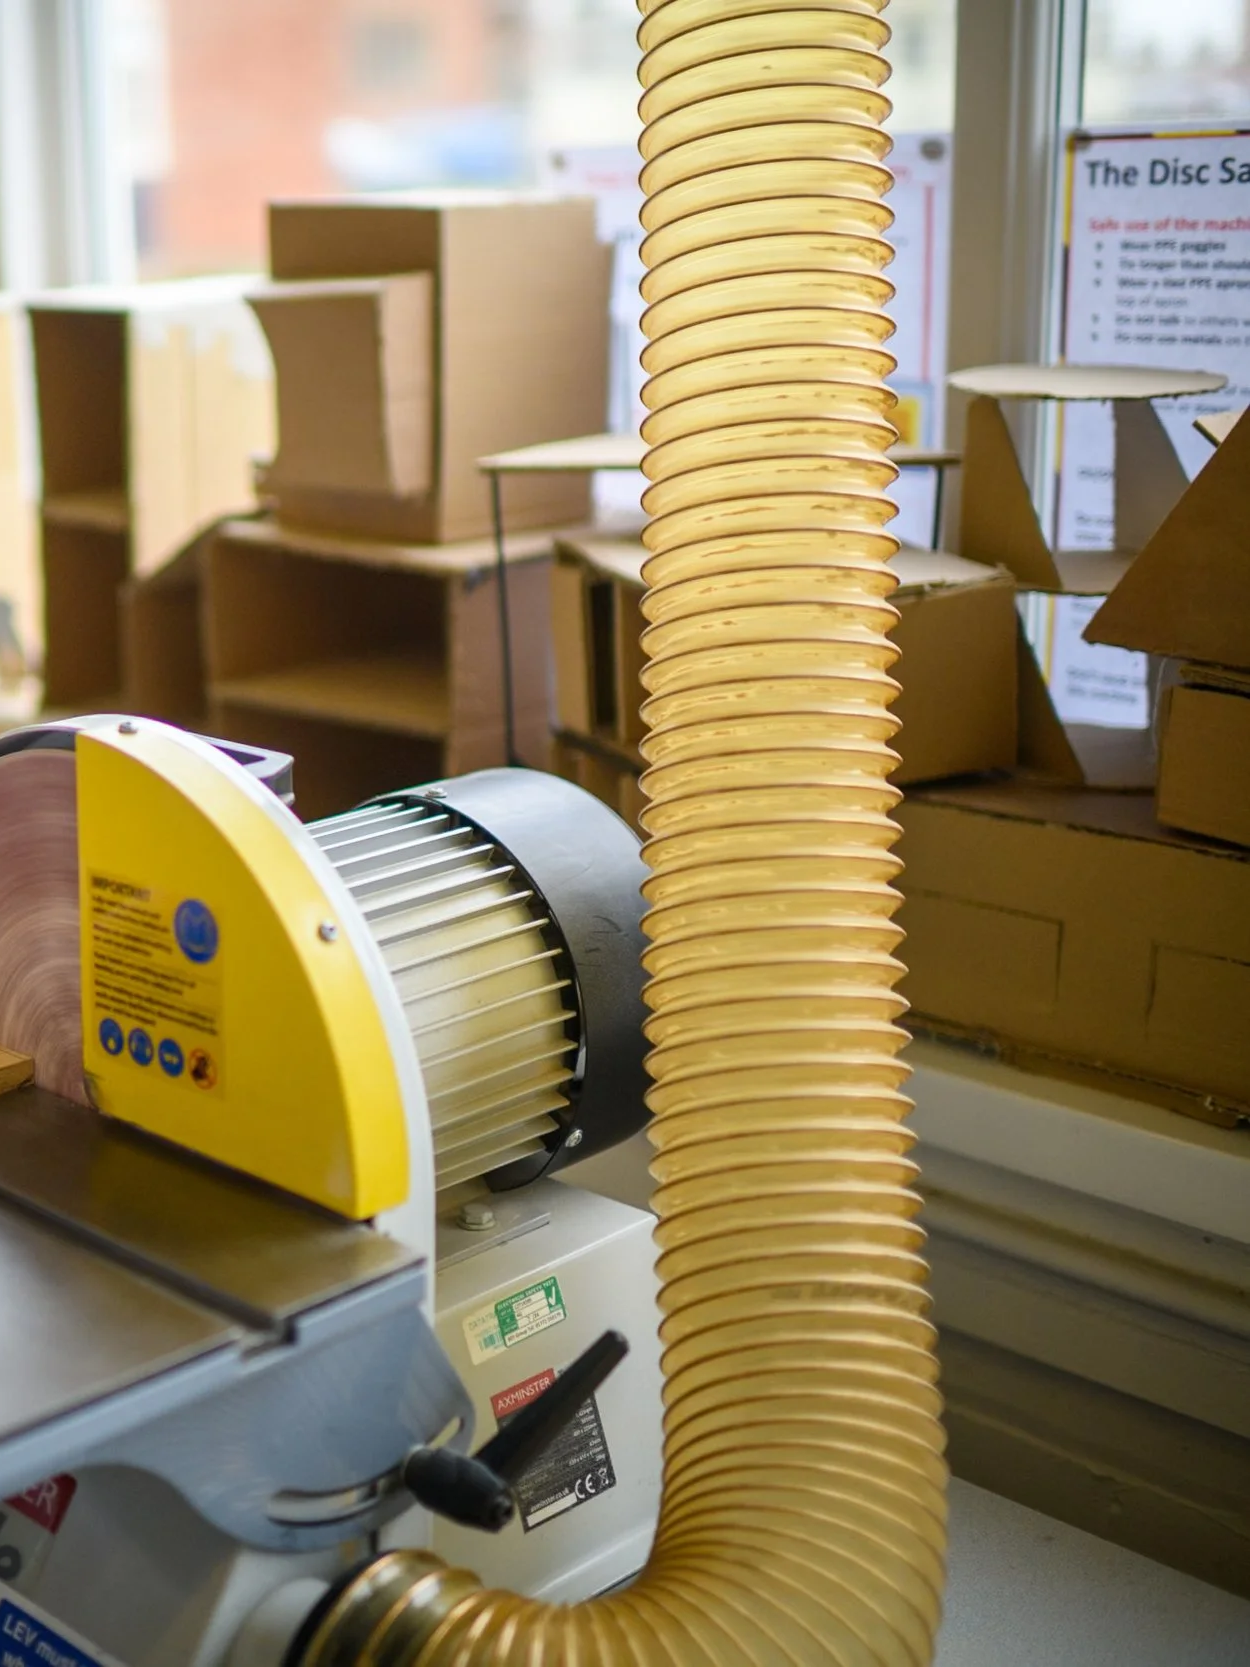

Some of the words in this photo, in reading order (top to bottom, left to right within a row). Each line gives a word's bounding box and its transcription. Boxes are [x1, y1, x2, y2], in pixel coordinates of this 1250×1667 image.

[1085, 158, 1139, 187] The
[1149, 157, 1211, 186] Disc
[1219, 157, 1250, 185] Sa
[1089, 216, 1119, 232] Safe
[1124, 219, 1150, 231] use
[1154, 216, 1171, 231] of
[1174, 216, 1200, 230] the
[1180, 240, 1226, 254] goggles
[497, 1376, 551, 1411] AXMINSTER
[2, 1614, 38, 1648] LEV
